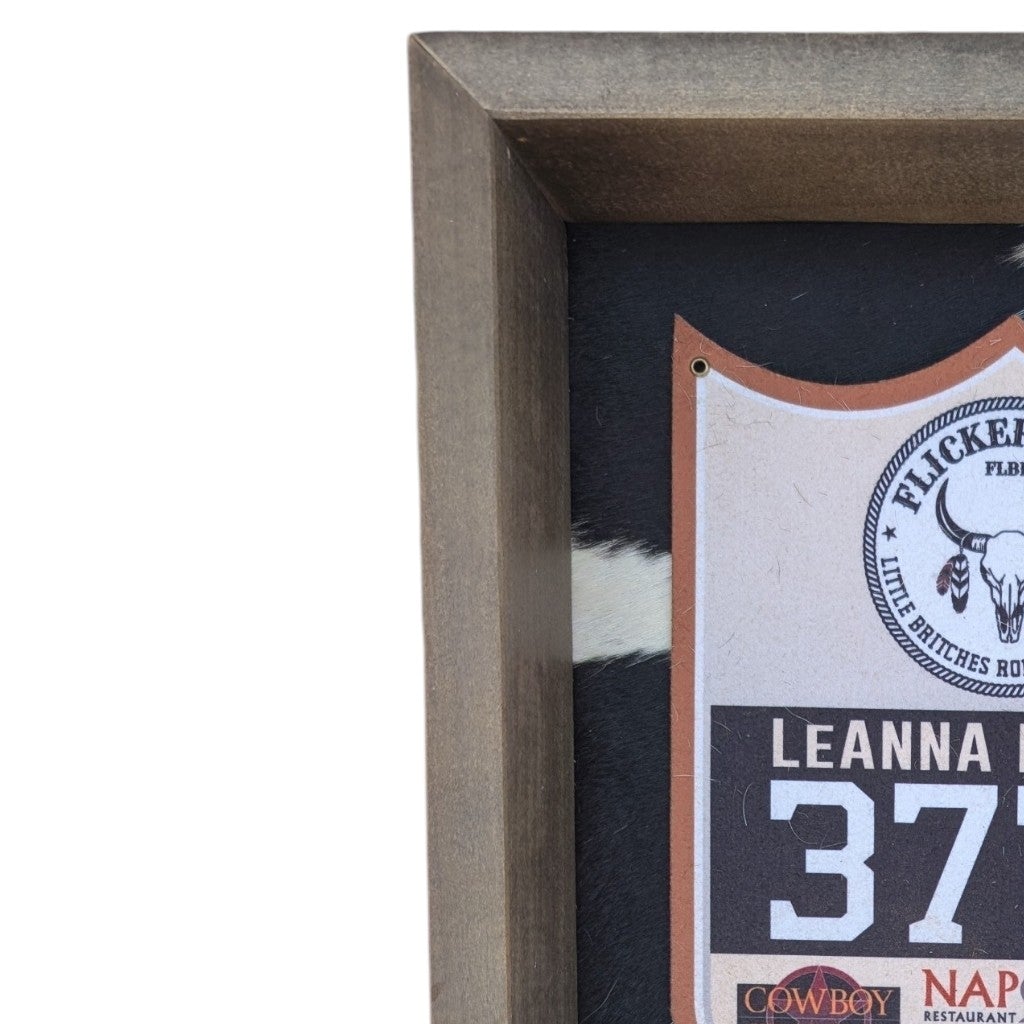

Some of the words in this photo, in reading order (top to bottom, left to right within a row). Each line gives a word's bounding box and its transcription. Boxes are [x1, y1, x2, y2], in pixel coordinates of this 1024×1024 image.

[880, 556, 915, 617] LITTLE
[908, 614, 991, 676] BRITCHES
[744, 986, 895, 1016] COWBOY
[923, 1010, 1017, 1023] RESTAURANT
